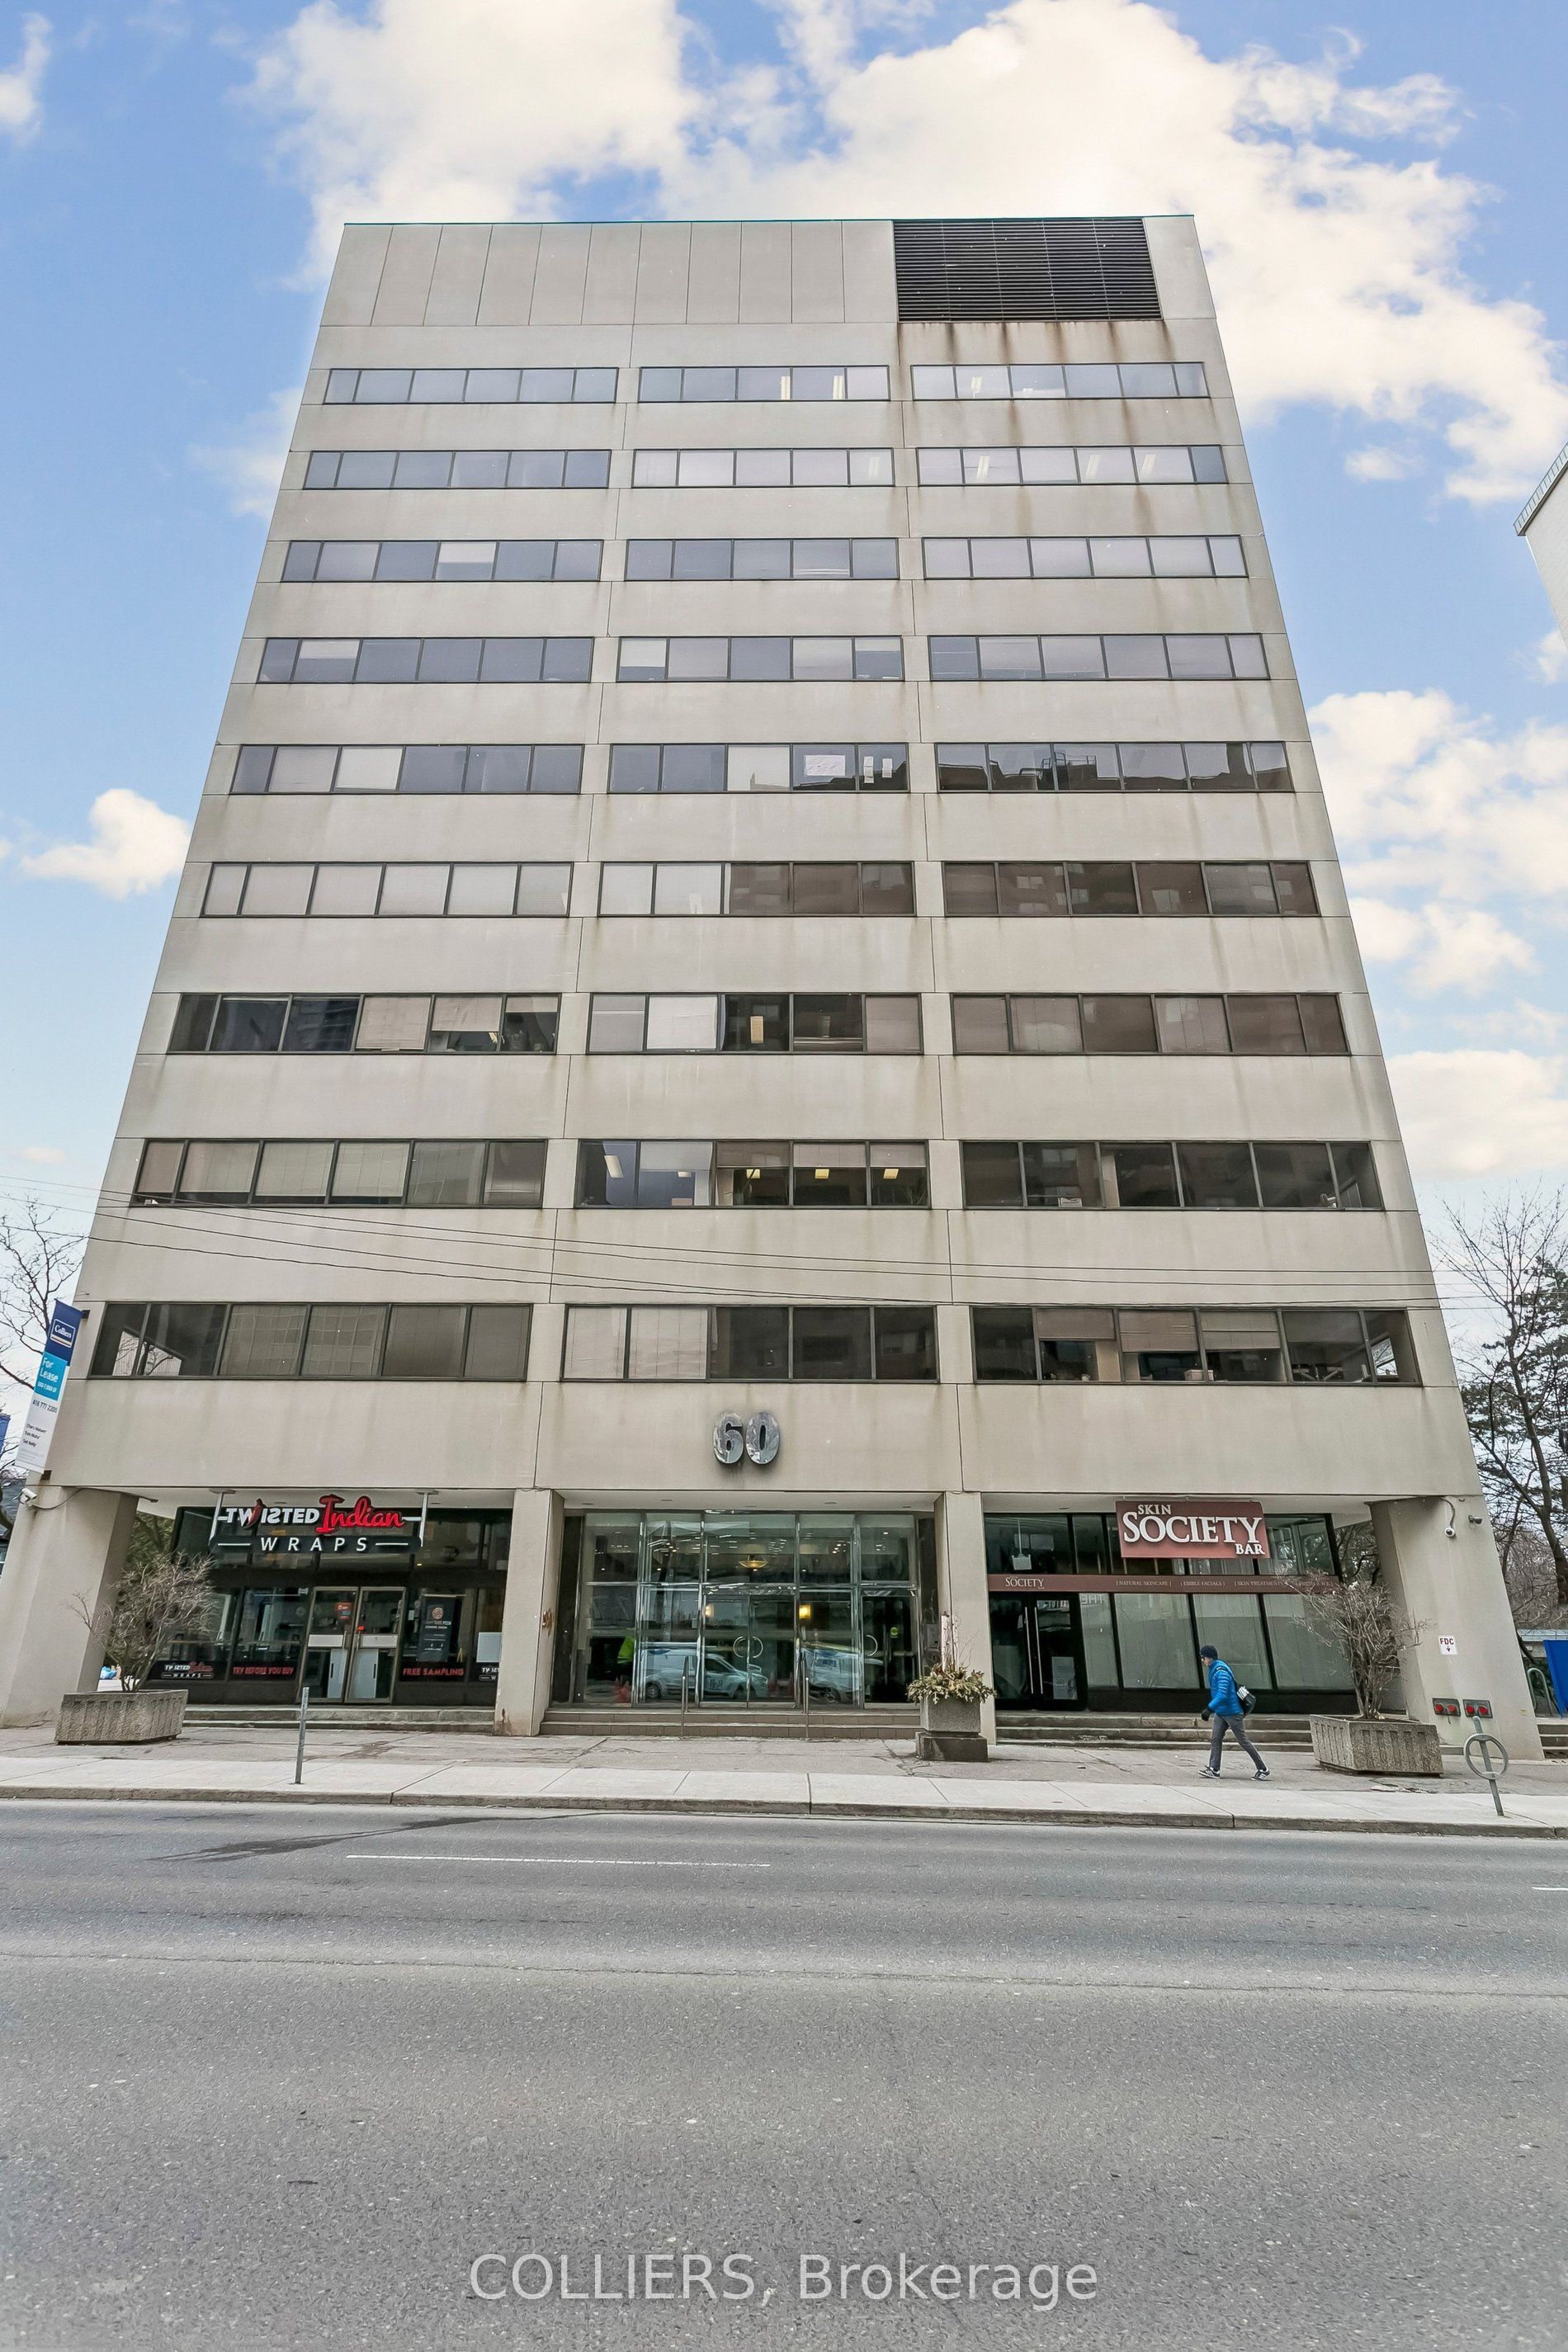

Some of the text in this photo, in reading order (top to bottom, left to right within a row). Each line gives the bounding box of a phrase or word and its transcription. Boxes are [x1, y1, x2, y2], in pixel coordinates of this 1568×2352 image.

[54, 1325, 72, 1339] Colliers
[42, 1357, 54, 1368] For
[40, 1367, 59, 1382] Lease
[713, 1412, 781, 1465] 60
[226, 1495, 405, 1537] TWISTED Indian
[1137, 1504, 1172, 1515] SKIN
[1122, 1511, 1263, 1543] SOCIETY
[261, 1537, 367, 1551] WRAPS
[1235, 1543, 1265, 1555] BAR
[1005, 1577, 1044, 1587] SOCIETY
[1439, 1637, 1454, 1646] FDC
[403, 1668, 464, 1676] FREE SAMPLING
